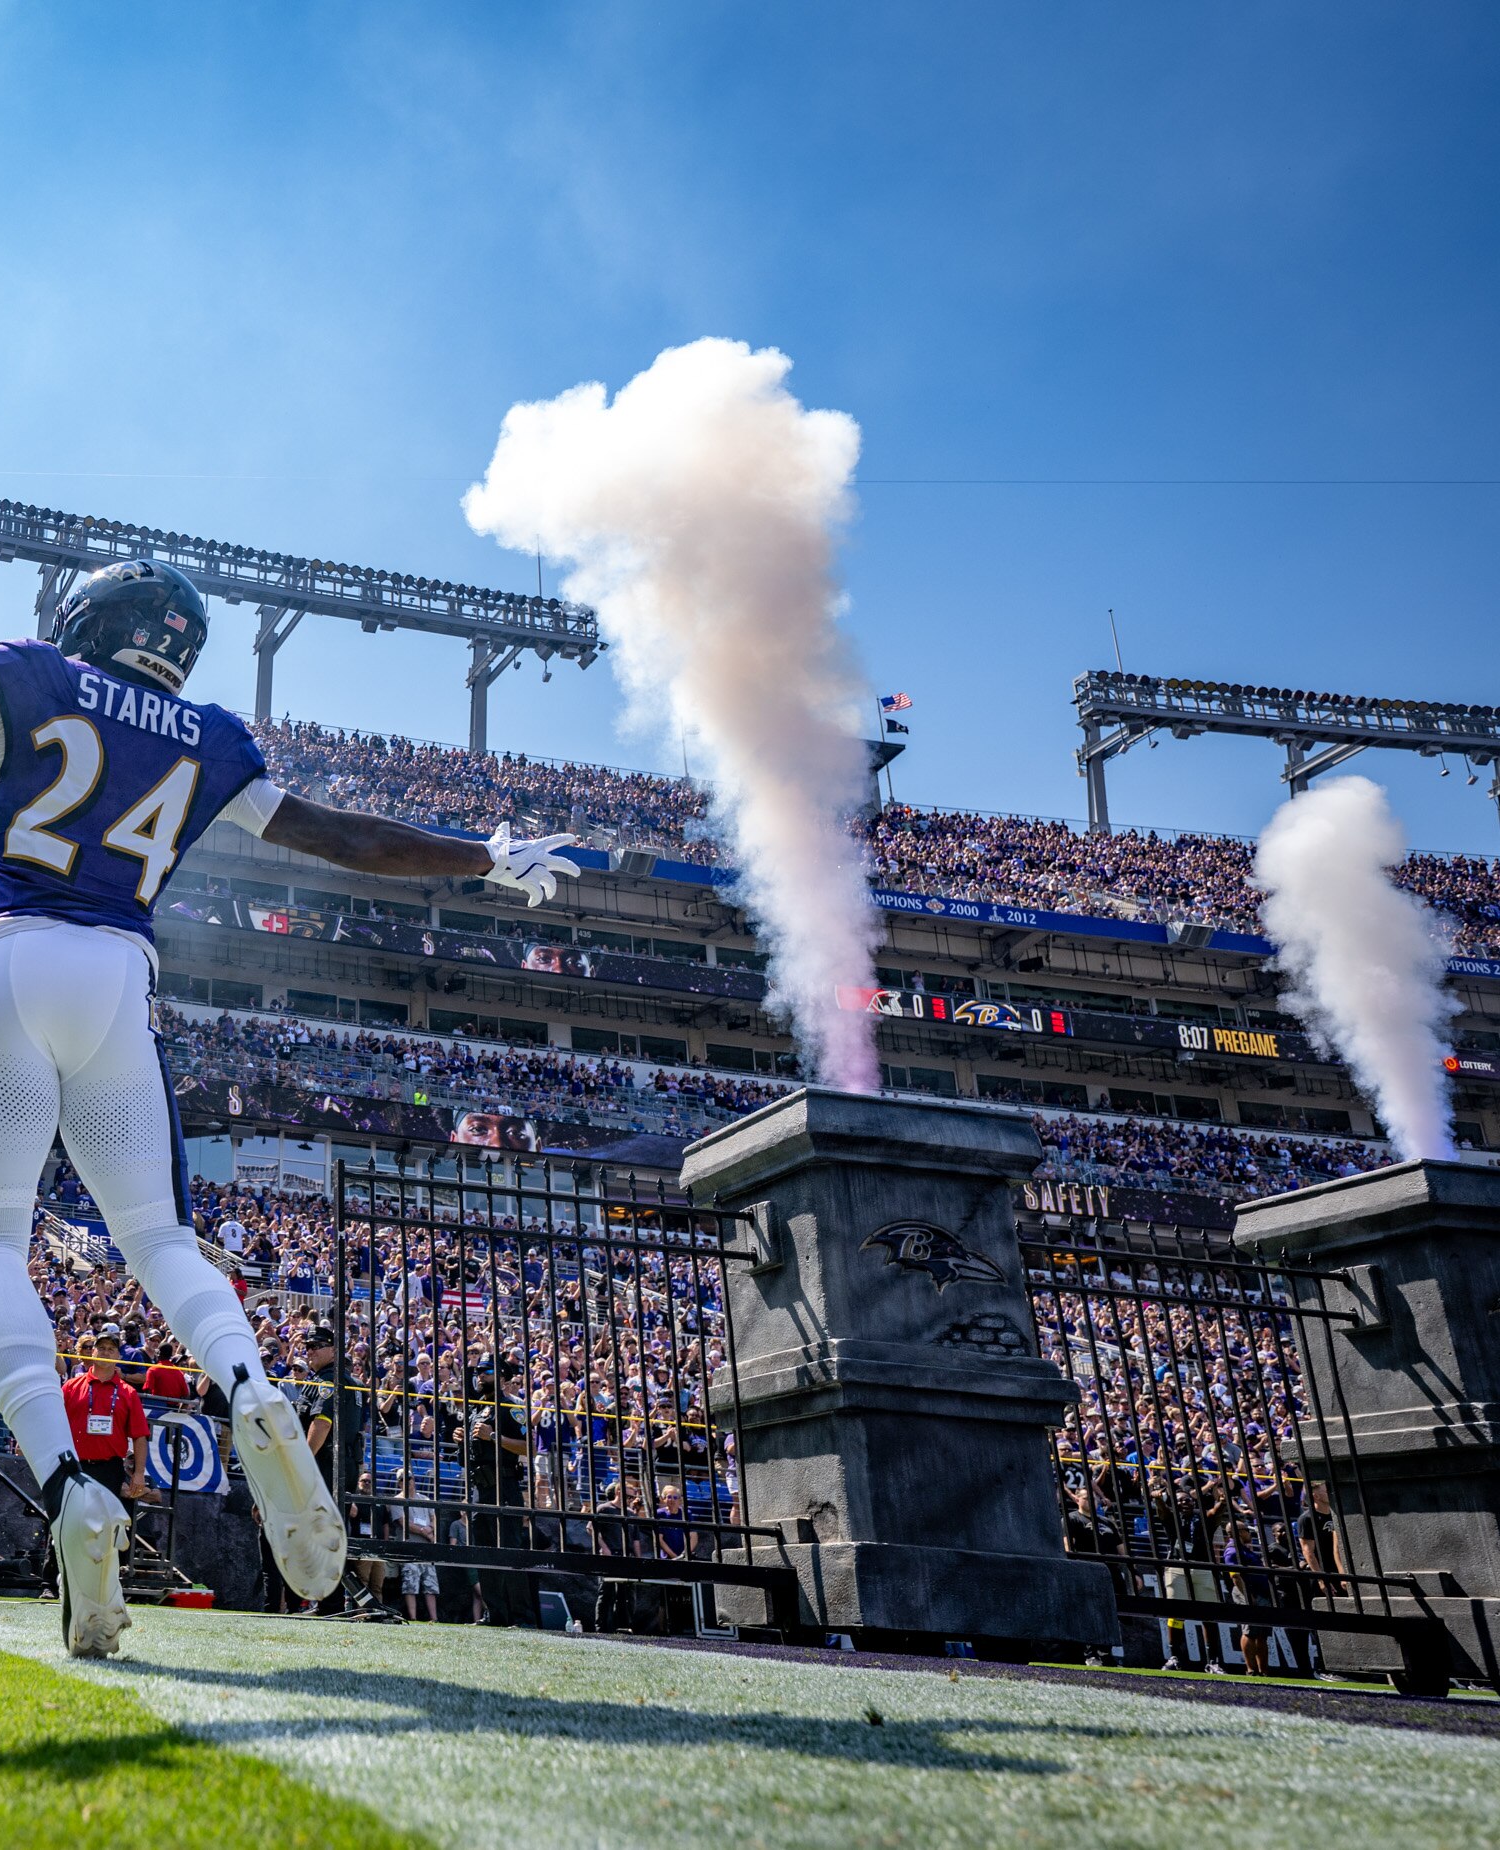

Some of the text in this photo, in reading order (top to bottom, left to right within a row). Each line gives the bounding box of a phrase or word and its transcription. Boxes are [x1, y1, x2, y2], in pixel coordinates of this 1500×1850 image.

[156, 634, 190, 665] 24
[135, 654, 183, 689] RAVENS
[78, 673, 201, 747] STARKS
[3, 714, 201, 907] 24
[950, 904, 979, 917] 2000
[1007, 911, 1037, 925] 2012
[578, 930, 592, 939] 435
[913, 994, 924, 1019] 0
[1032, 1009, 1043, 1033] 0
[1178, 1025, 1280, 1058] 8:07 PREGAME
[1459, 1061, 1492, 1071] LOTTERY
[1023, 1181, 1109, 1217] SAFETY
[231, 1228, 237, 1238] 8
[297, 1267, 311, 1278] 89
[574, 1301, 580, 1311] 8
[1064, 1470, 1085, 1489] 22
